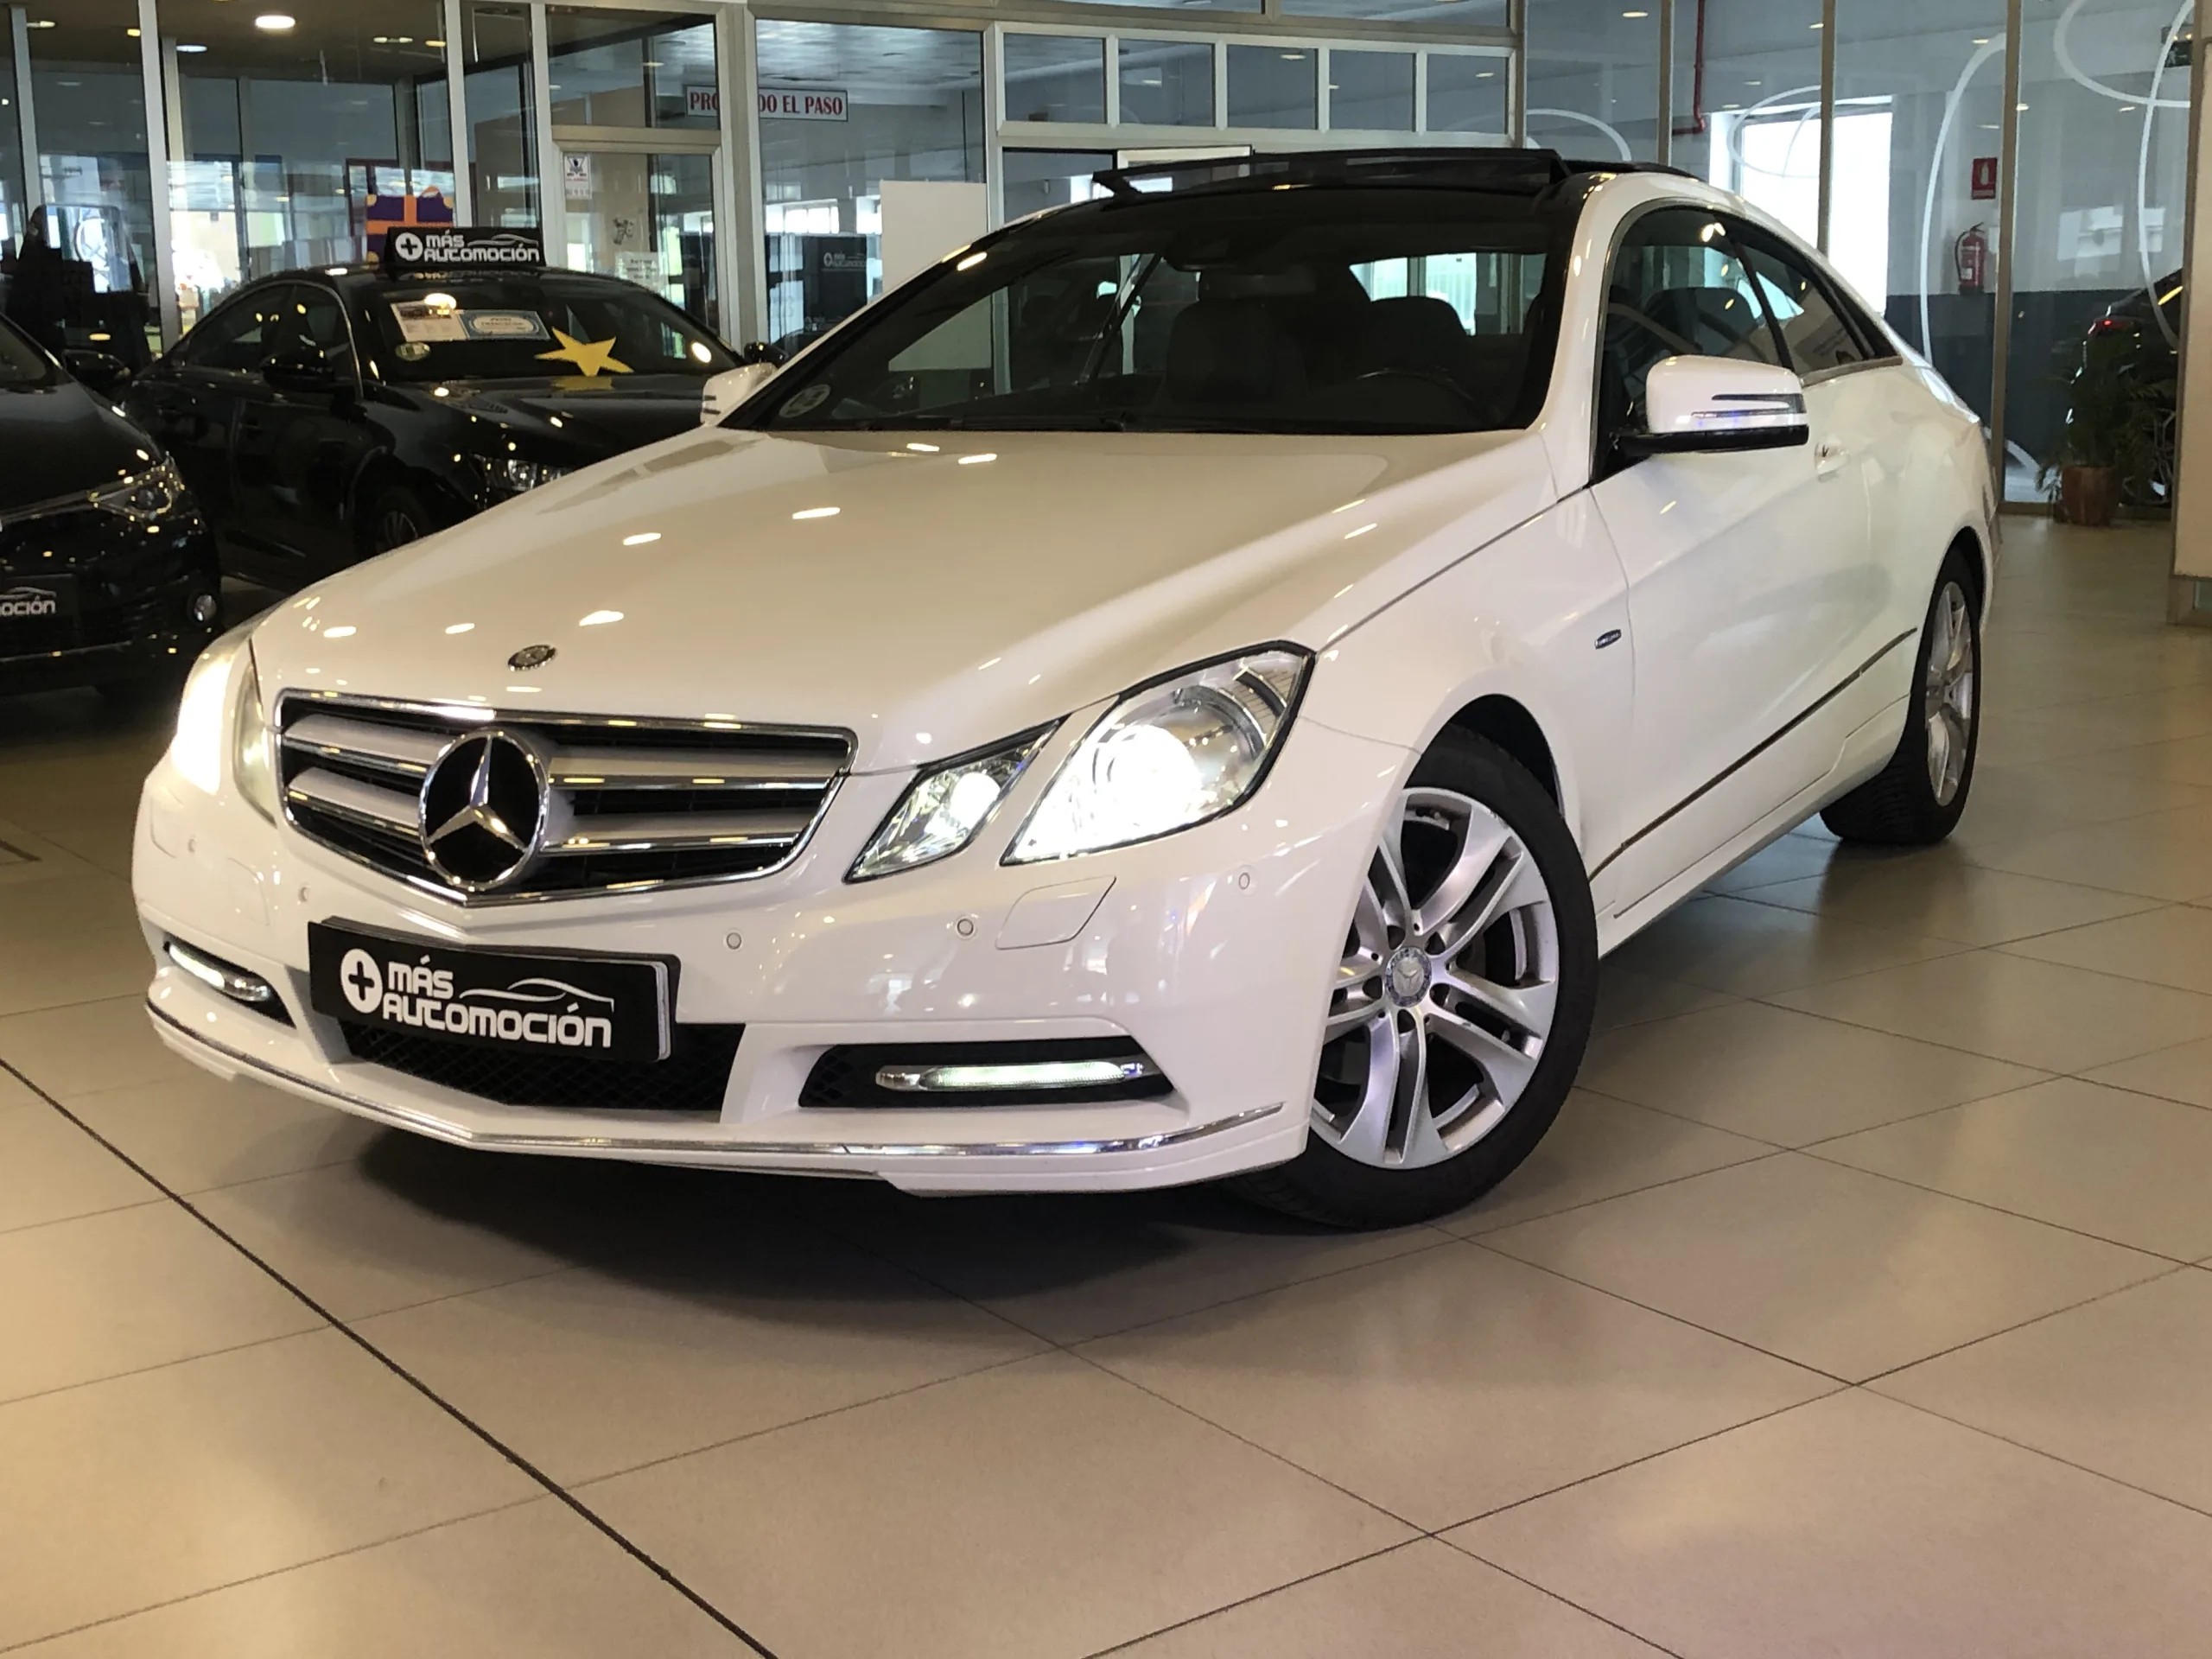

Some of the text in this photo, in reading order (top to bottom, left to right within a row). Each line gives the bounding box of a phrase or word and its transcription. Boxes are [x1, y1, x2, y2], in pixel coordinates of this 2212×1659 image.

[782, 95, 801, 114] EL
[804, 96, 843, 115] PASO
[388, 954, 454, 1000] MÁS
